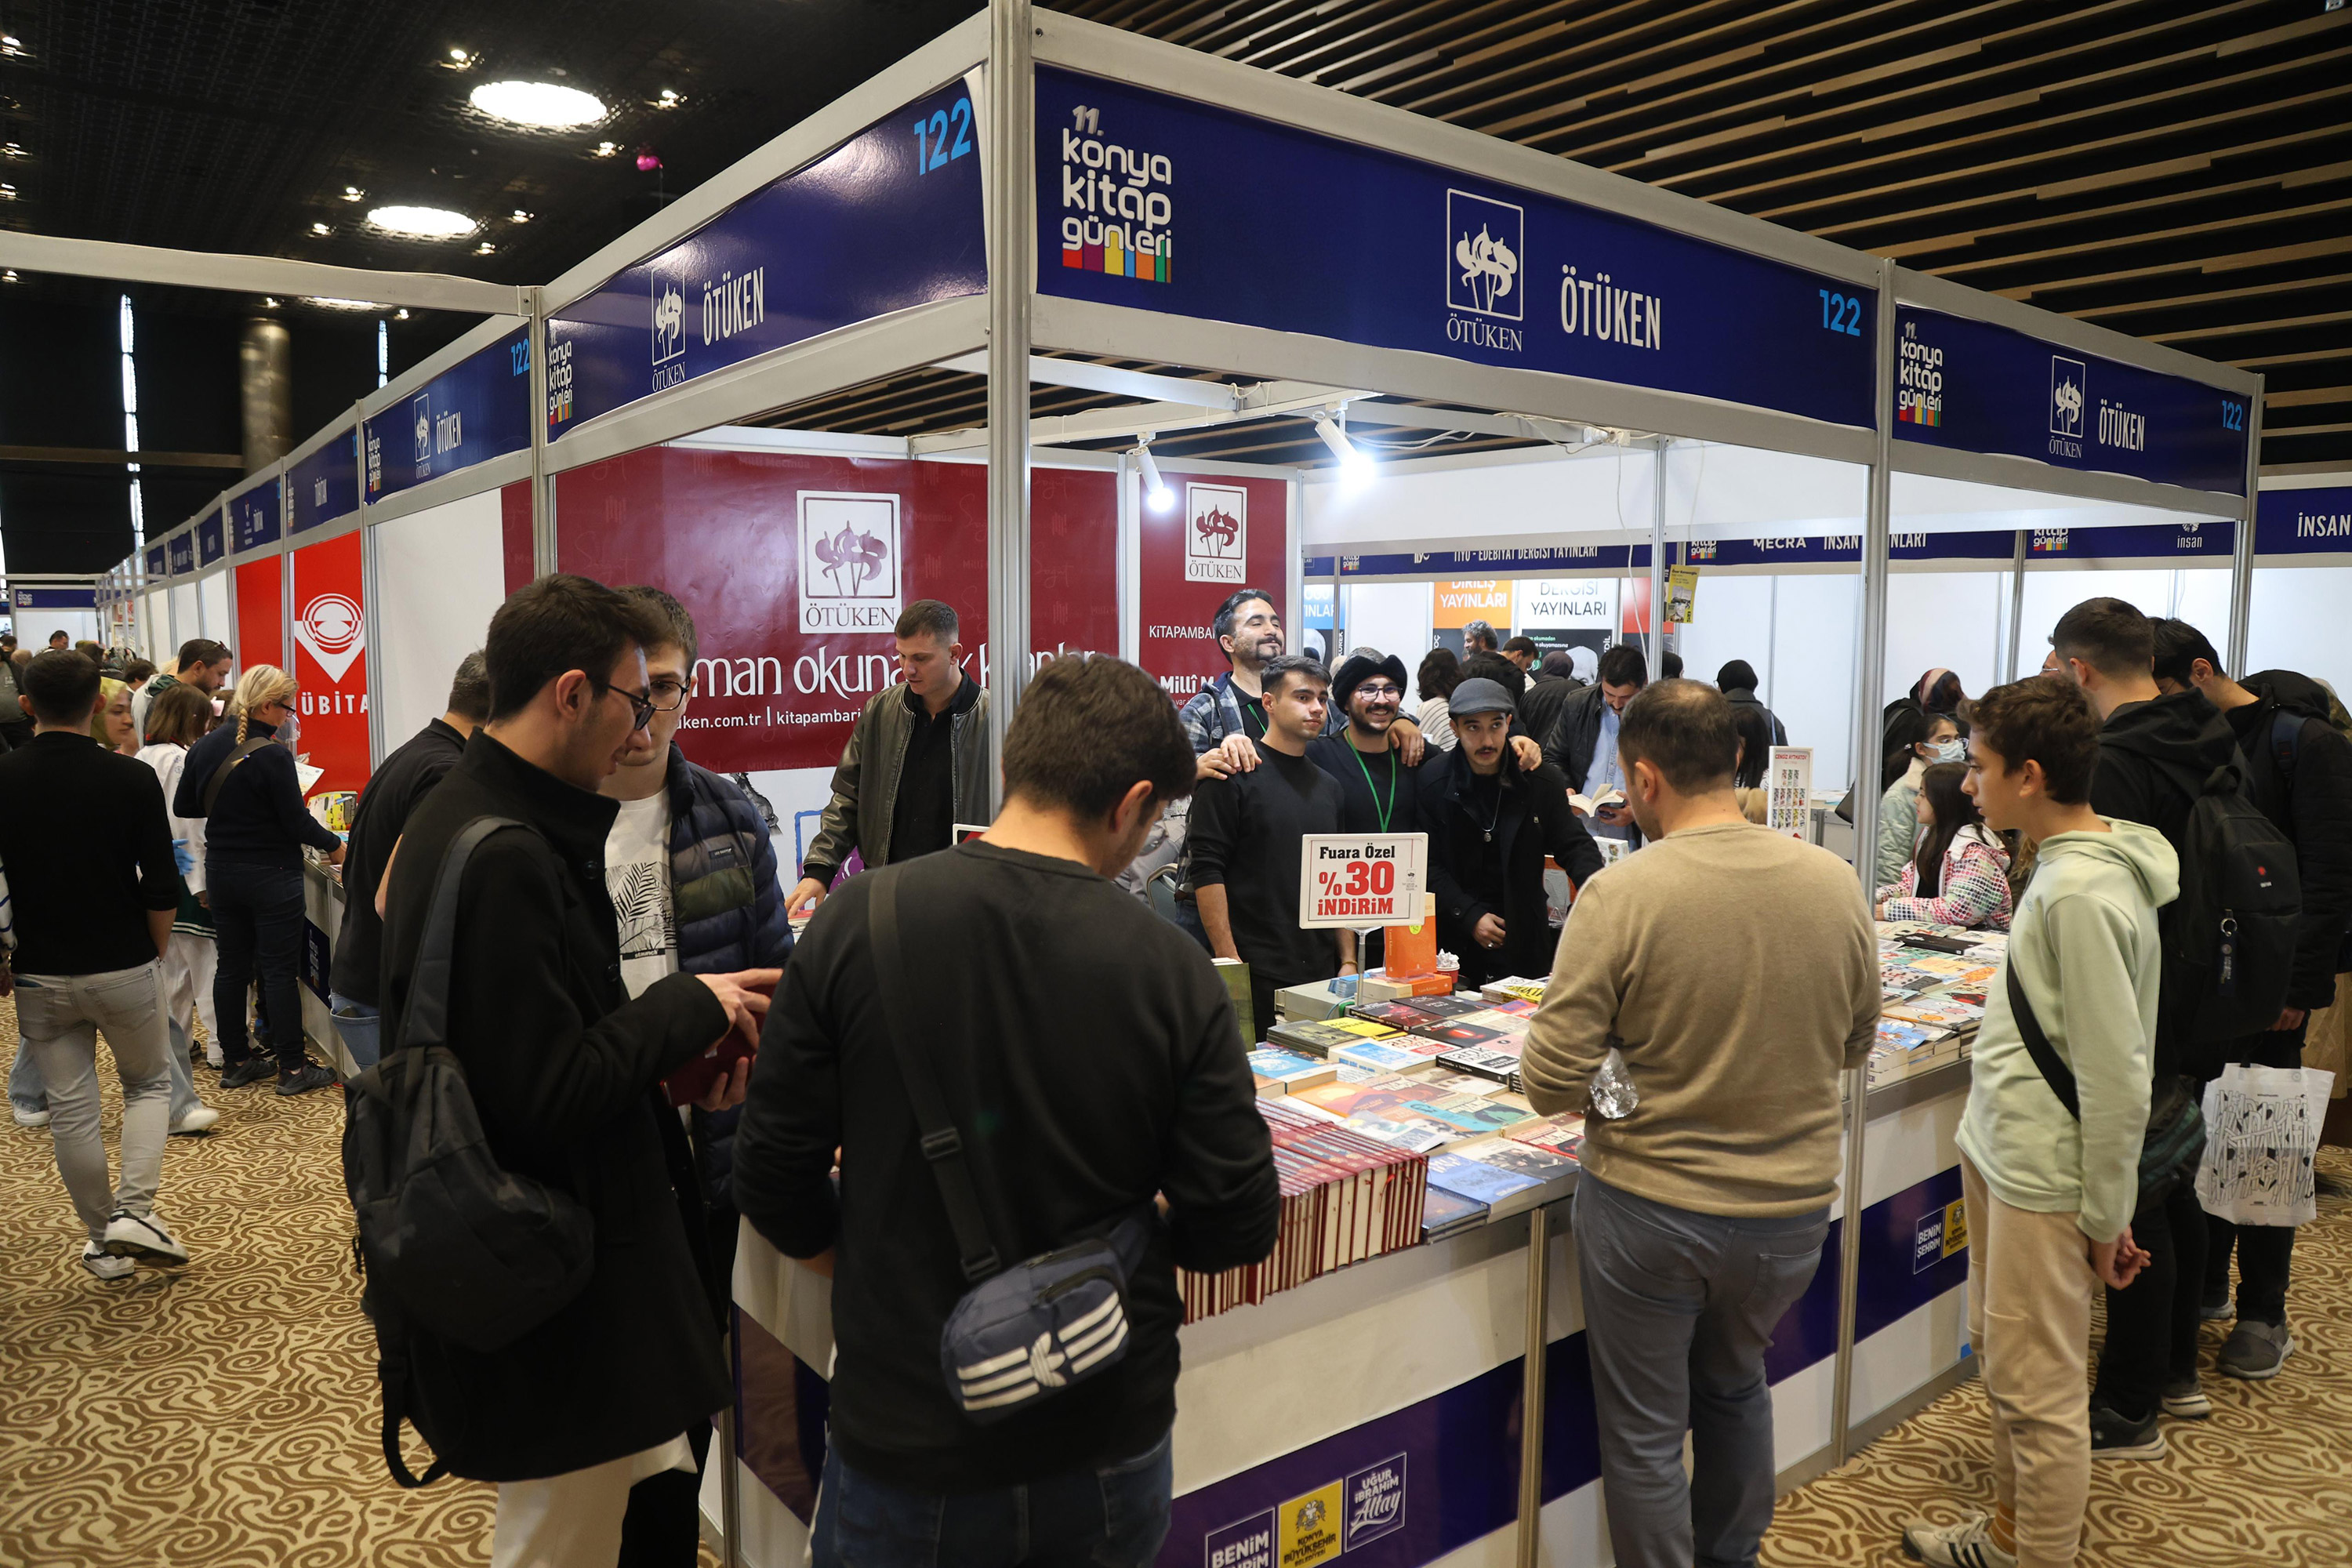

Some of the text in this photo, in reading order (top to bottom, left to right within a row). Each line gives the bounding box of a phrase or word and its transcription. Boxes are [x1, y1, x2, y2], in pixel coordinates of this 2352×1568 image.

[1072, 104, 1105, 136] 11.
[914, 96, 972, 176] 122
[1062, 127, 1171, 187] konya
[1062, 165, 1171, 230] kitap
[1062, 215, 1171, 259] günleri
[702, 267, 764, 347] ÖTÜKEN
[1560, 263, 1661, 350] ÖTÜKEN
[1819, 289, 1861, 337] 122
[1446, 313, 1523, 352] ÖTÜKEN
[1904, 321, 1918, 340] 11.
[510, 338, 530, 377] 122
[549, 340, 572, 366] konya
[1900, 336, 1944, 369] konya
[549, 363, 572, 392] kitap
[652, 361, 686, 392] ÖTÜKEN
[1900, 358, 1942, 395] kitap
[549, 384, 573, 416] günleri
[1899, 388, 1942, 412] günleri
[2221, 400, 2243, 431] 122
[436, 410, 462, 455] ÖTÜKEN
[2098, 398, 2145, 452] ÖTÜKEN
[2049, 436, 2082, 459] ÖTÜKEN
[416, 462, 431, 480] ÖTÜKEN
[2297, 511, 2351, 538] İNSAN
[2034, 535, 2068, 547] günleri
[2177, 535, 2203, 549] insan
[1189, 559, 1243, 579] ÖTÜKEN
[804, 602, 895, 628] ÖTÜKEN
[1439, 592, 1508, 608] YAYINLARI
[1530, 601, 1607, 616] YAYINLARI
[691, 655, 783, 698] man
[1319, 842, 1396, 860] Fuara Özel
[1918, 1222, 1942, 1245] BENİM
[1361, 1468, 1392, 1490] UĞUR
[1350, 1490, 1402, 1530] Altay
[1211, 1530, 1269, 1568] BENİM
[1298, 1530, 1324, 1547] KONYA
